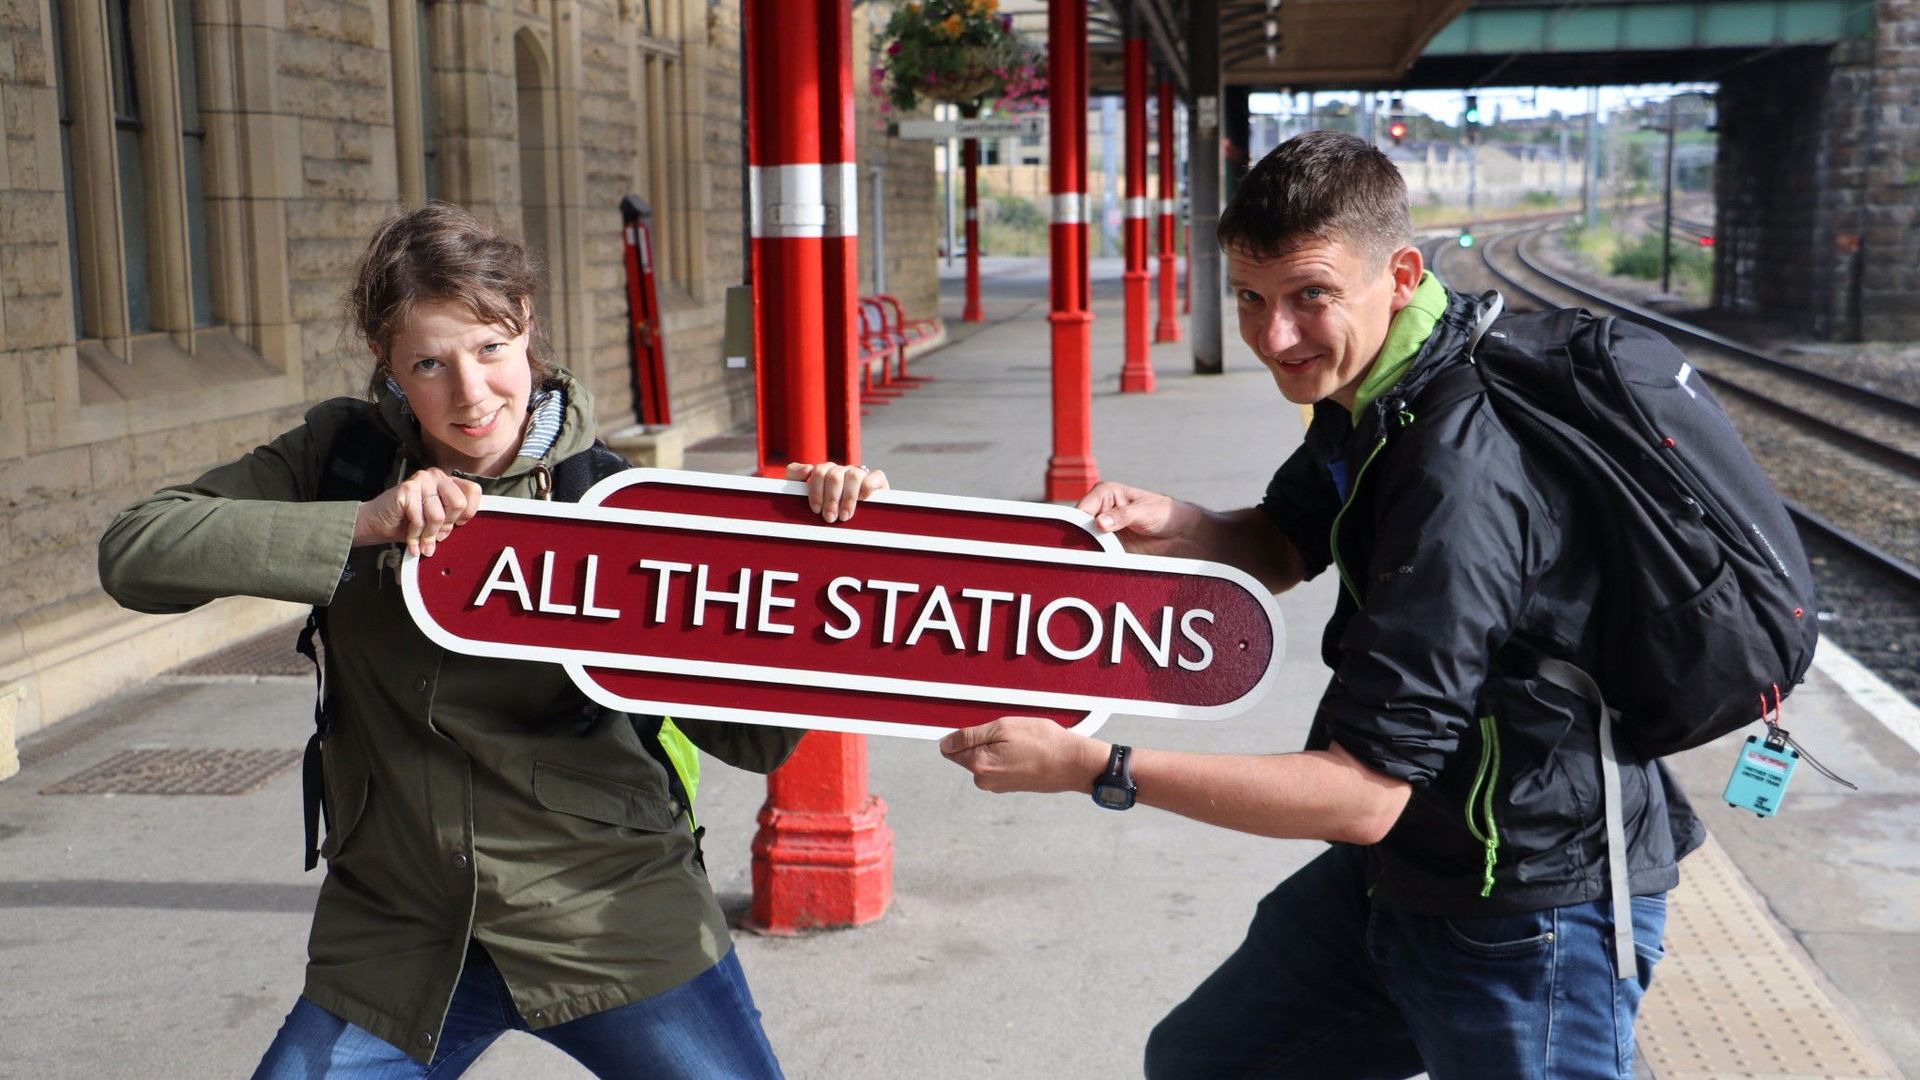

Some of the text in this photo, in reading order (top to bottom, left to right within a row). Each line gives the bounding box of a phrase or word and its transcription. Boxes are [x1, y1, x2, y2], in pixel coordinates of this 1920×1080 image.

[473, 546, 1214, 672] ALL THE STATIONS
